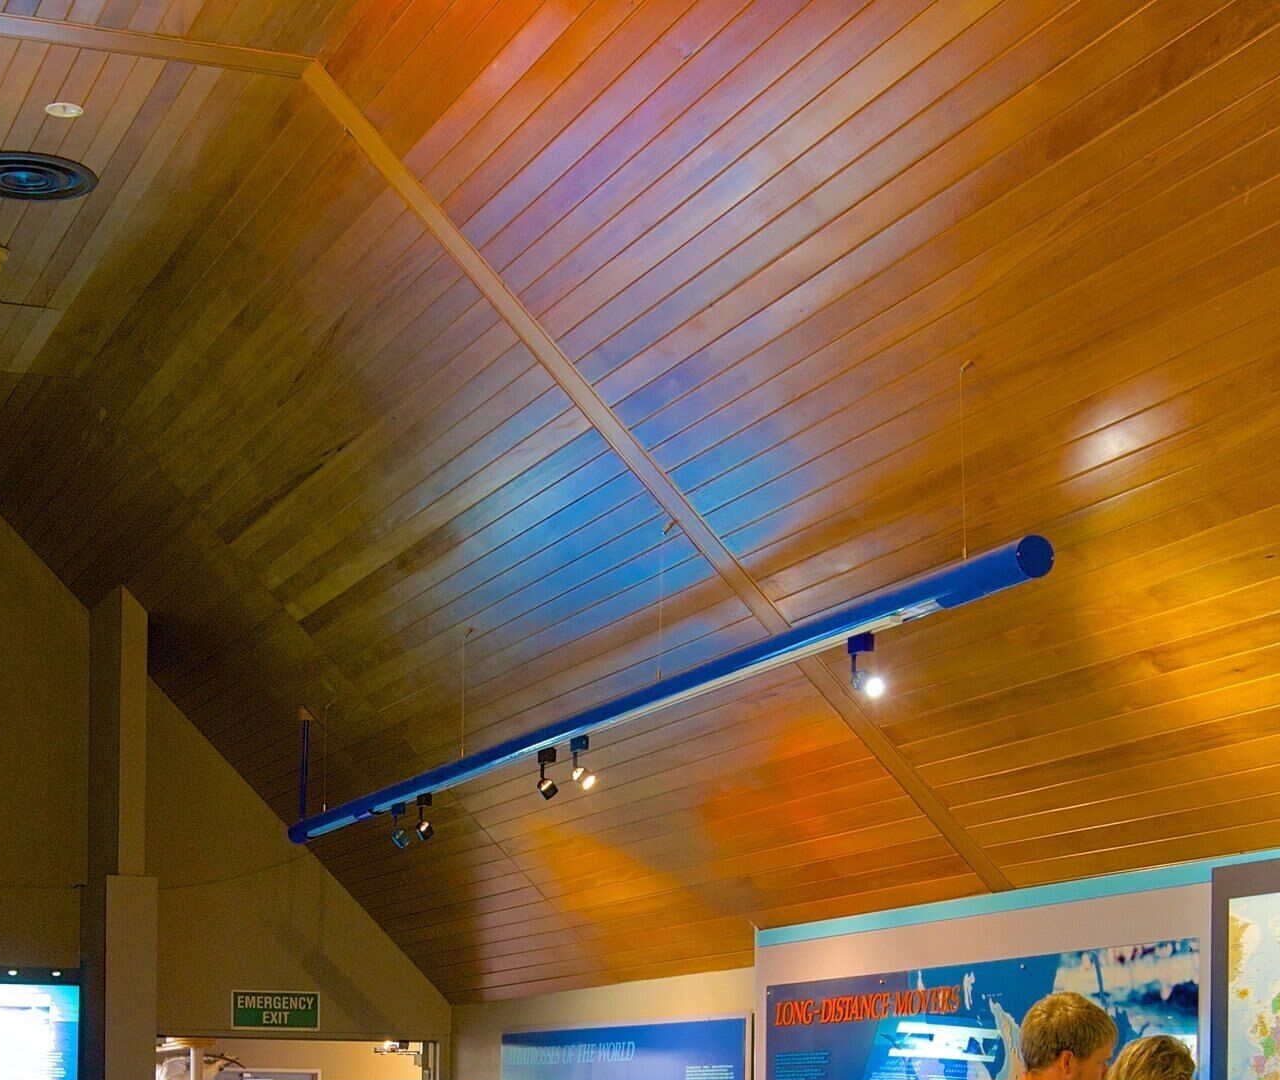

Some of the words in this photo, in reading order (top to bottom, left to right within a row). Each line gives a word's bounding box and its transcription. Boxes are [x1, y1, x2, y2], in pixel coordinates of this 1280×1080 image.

[237, 995, 314, 1010] EMERGENCY
[774, 992, 890, 1028] LONG-DISTANCE
[893, 985, 961, 1017] MOVERS
[262, 1011, 290, 1024] EXIT
[562, 1045, 576, 1064] OF
[577, 1043, 596, 1063] THE
[597, 1041, 635, 1062] WORLD
